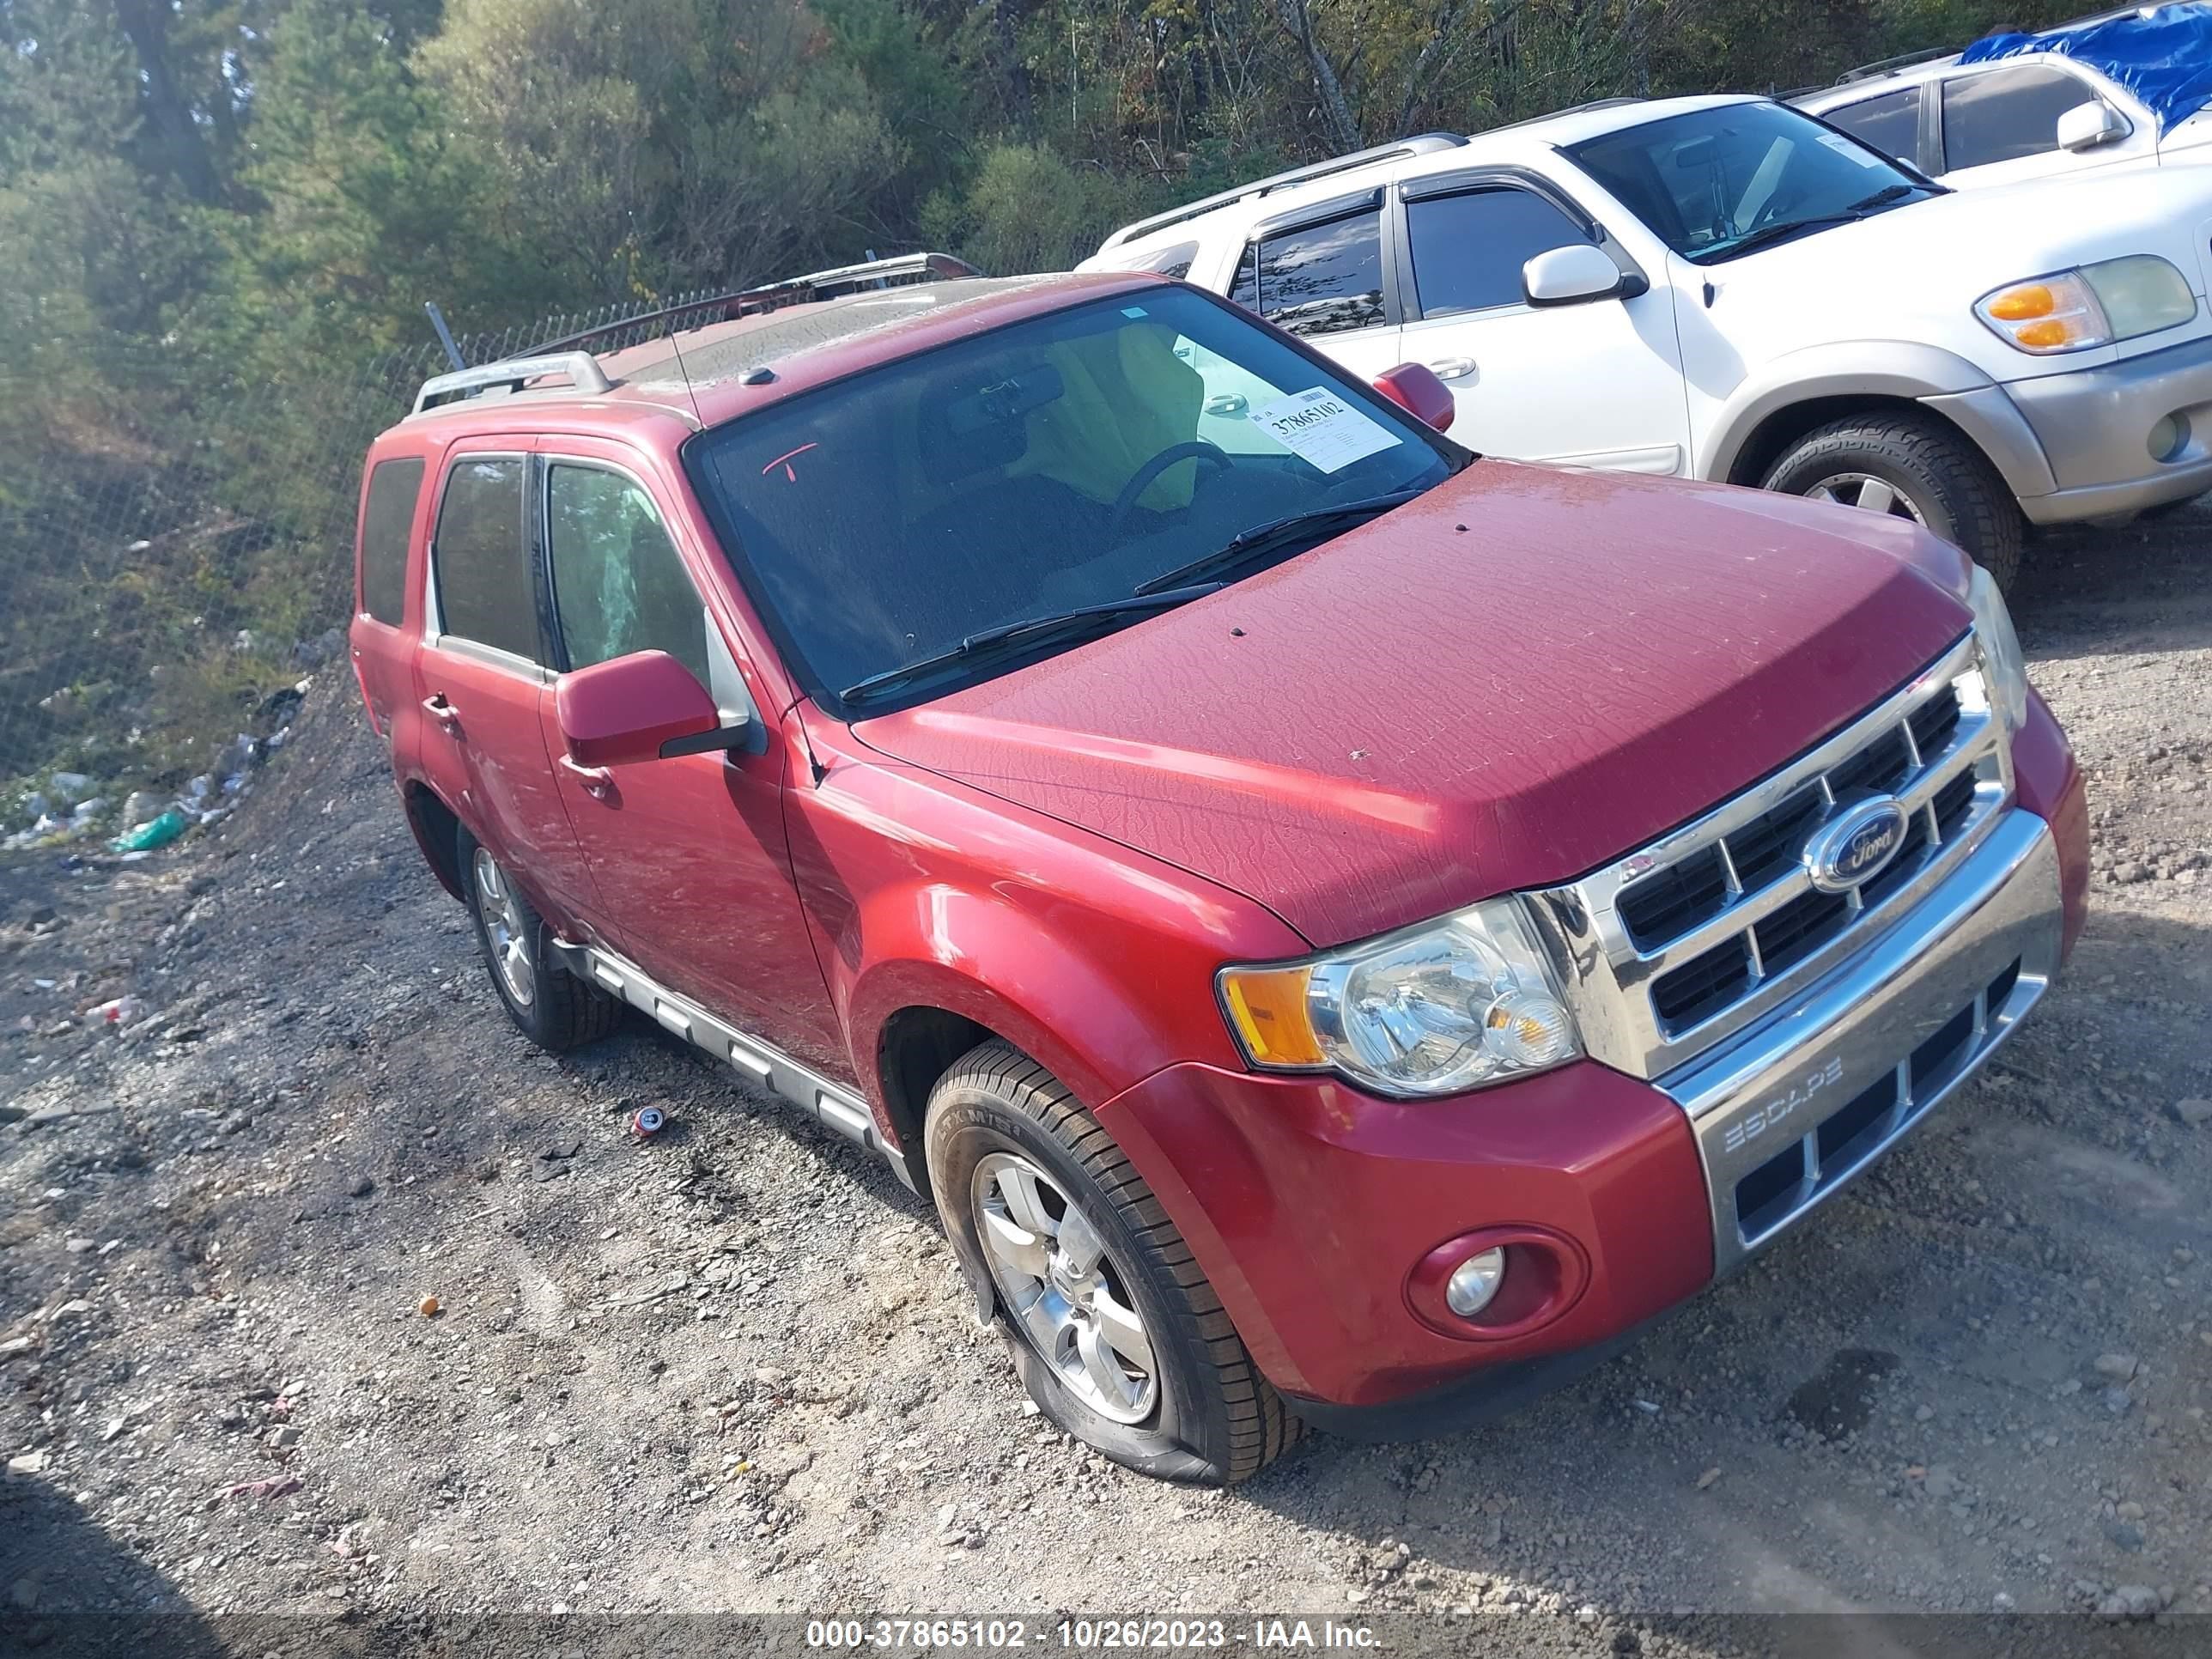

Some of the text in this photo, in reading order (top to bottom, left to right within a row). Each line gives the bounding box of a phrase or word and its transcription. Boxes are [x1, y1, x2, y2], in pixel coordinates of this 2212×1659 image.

[1271, 401, 1345, 435] 37865102
[1851, 823, 1894, 868] Ford
[1724, 1055, 1844, 1153] ESCAPE
